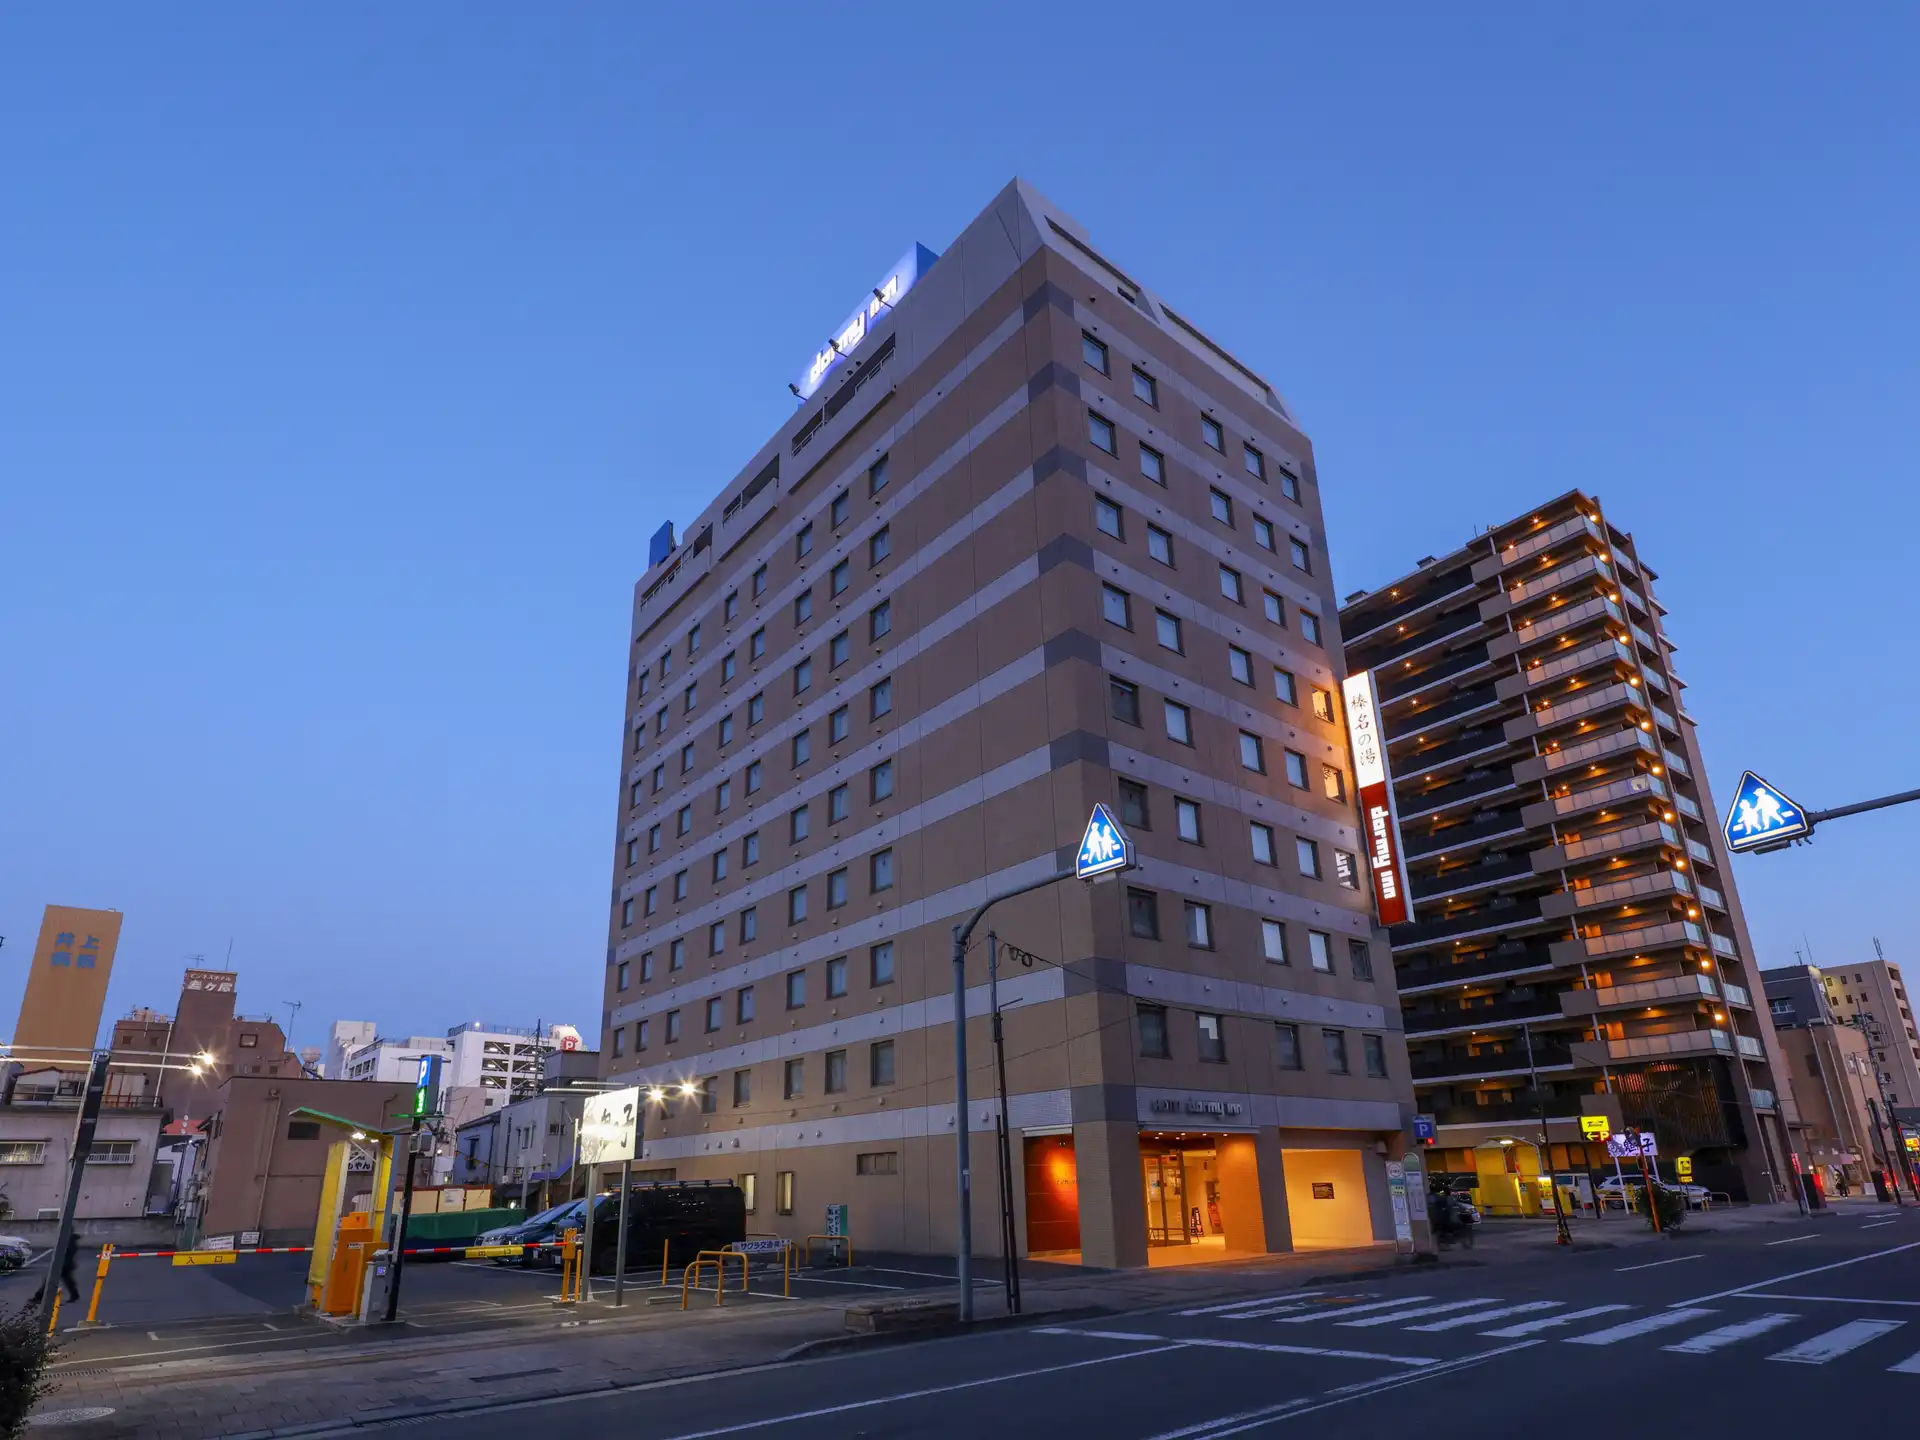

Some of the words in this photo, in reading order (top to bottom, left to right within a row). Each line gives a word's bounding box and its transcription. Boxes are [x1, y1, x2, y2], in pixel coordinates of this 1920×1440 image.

[1351, 693, 1376, 767] 榛名の湯
[1371, 806, 1390, 869] dormy
[1380, 870, 1396, 899] inn
[418, 1060, 427, 1086] P
[1419, 1123, 1429, 1137] P
[1600, 1131, 1610, 1142] P
[186, 1255, 223, 1265] 入口
